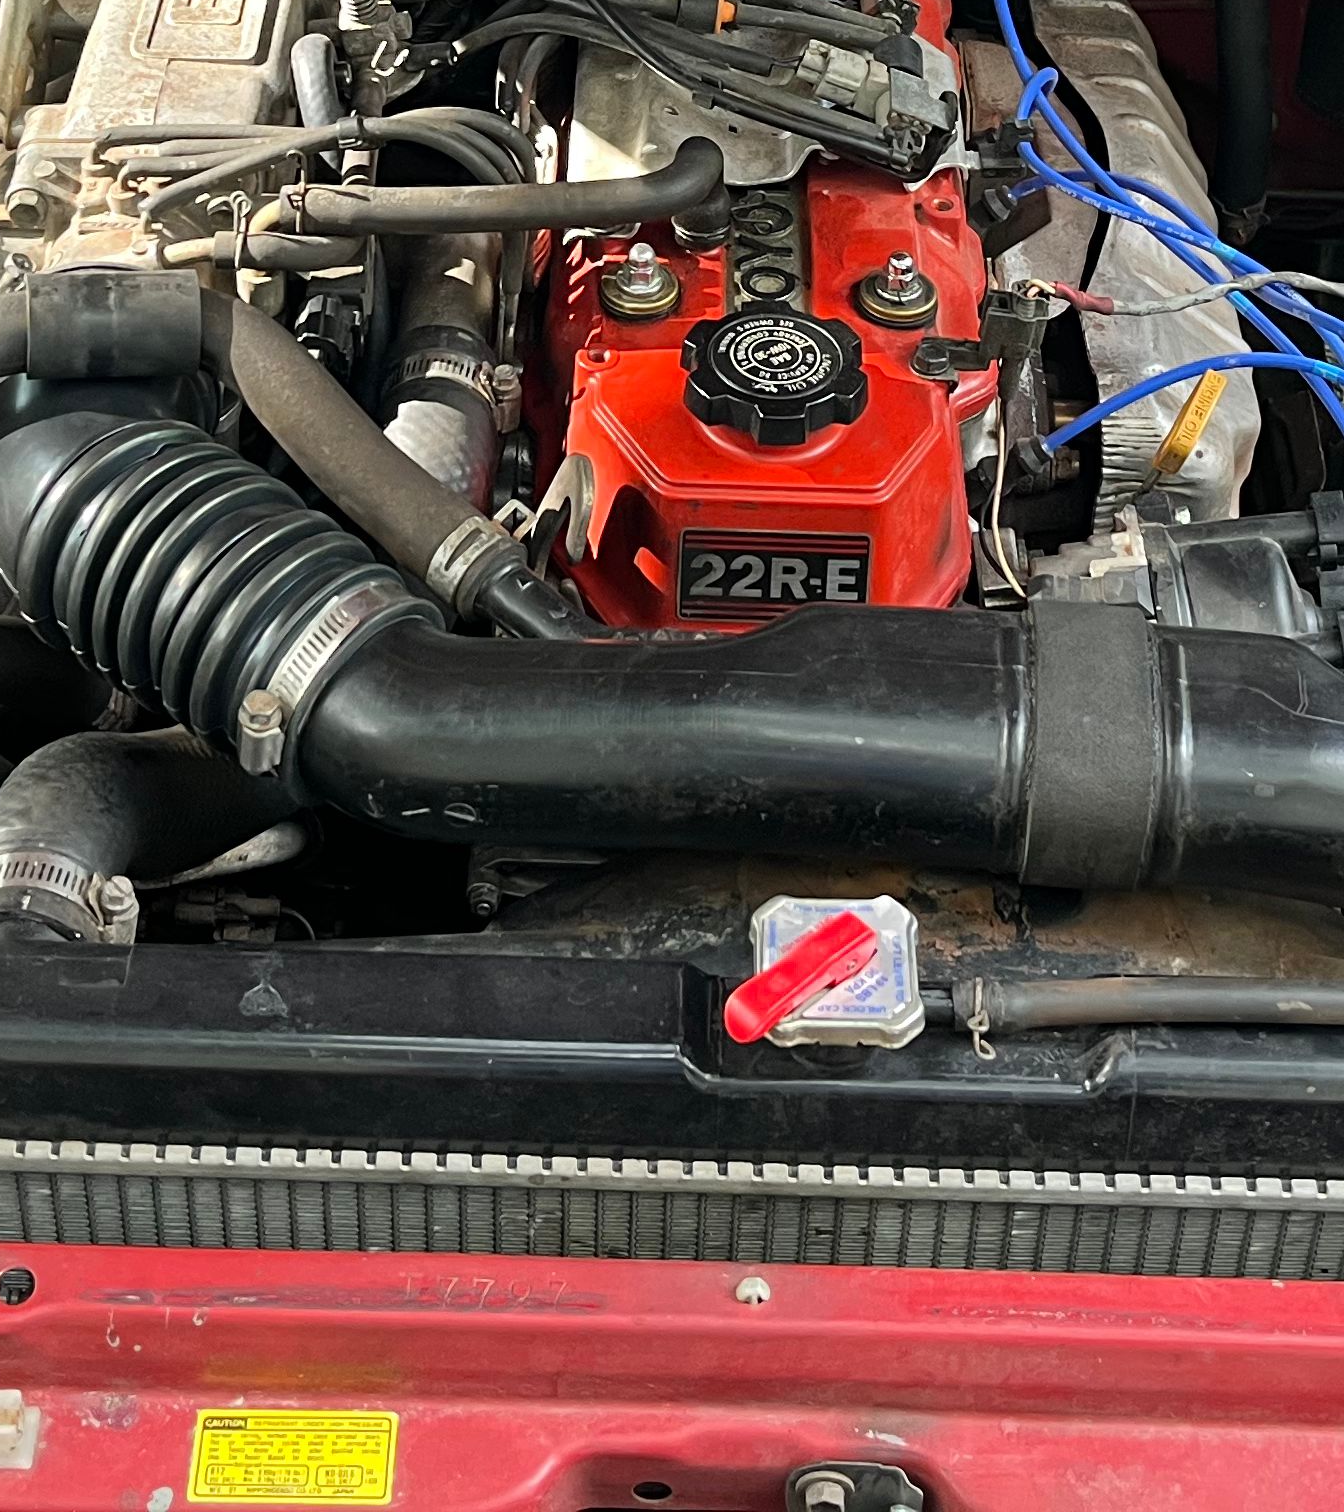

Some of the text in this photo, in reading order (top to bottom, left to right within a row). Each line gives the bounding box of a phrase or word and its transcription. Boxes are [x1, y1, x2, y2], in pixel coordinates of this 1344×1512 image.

[784, 381, 807, 393] OIL
[689, 553, 861, 601] 22R-E
[818, 1004, 886, 1014] UNLOCK CAP
[205, 1418, 245, 1428] CAUTION
